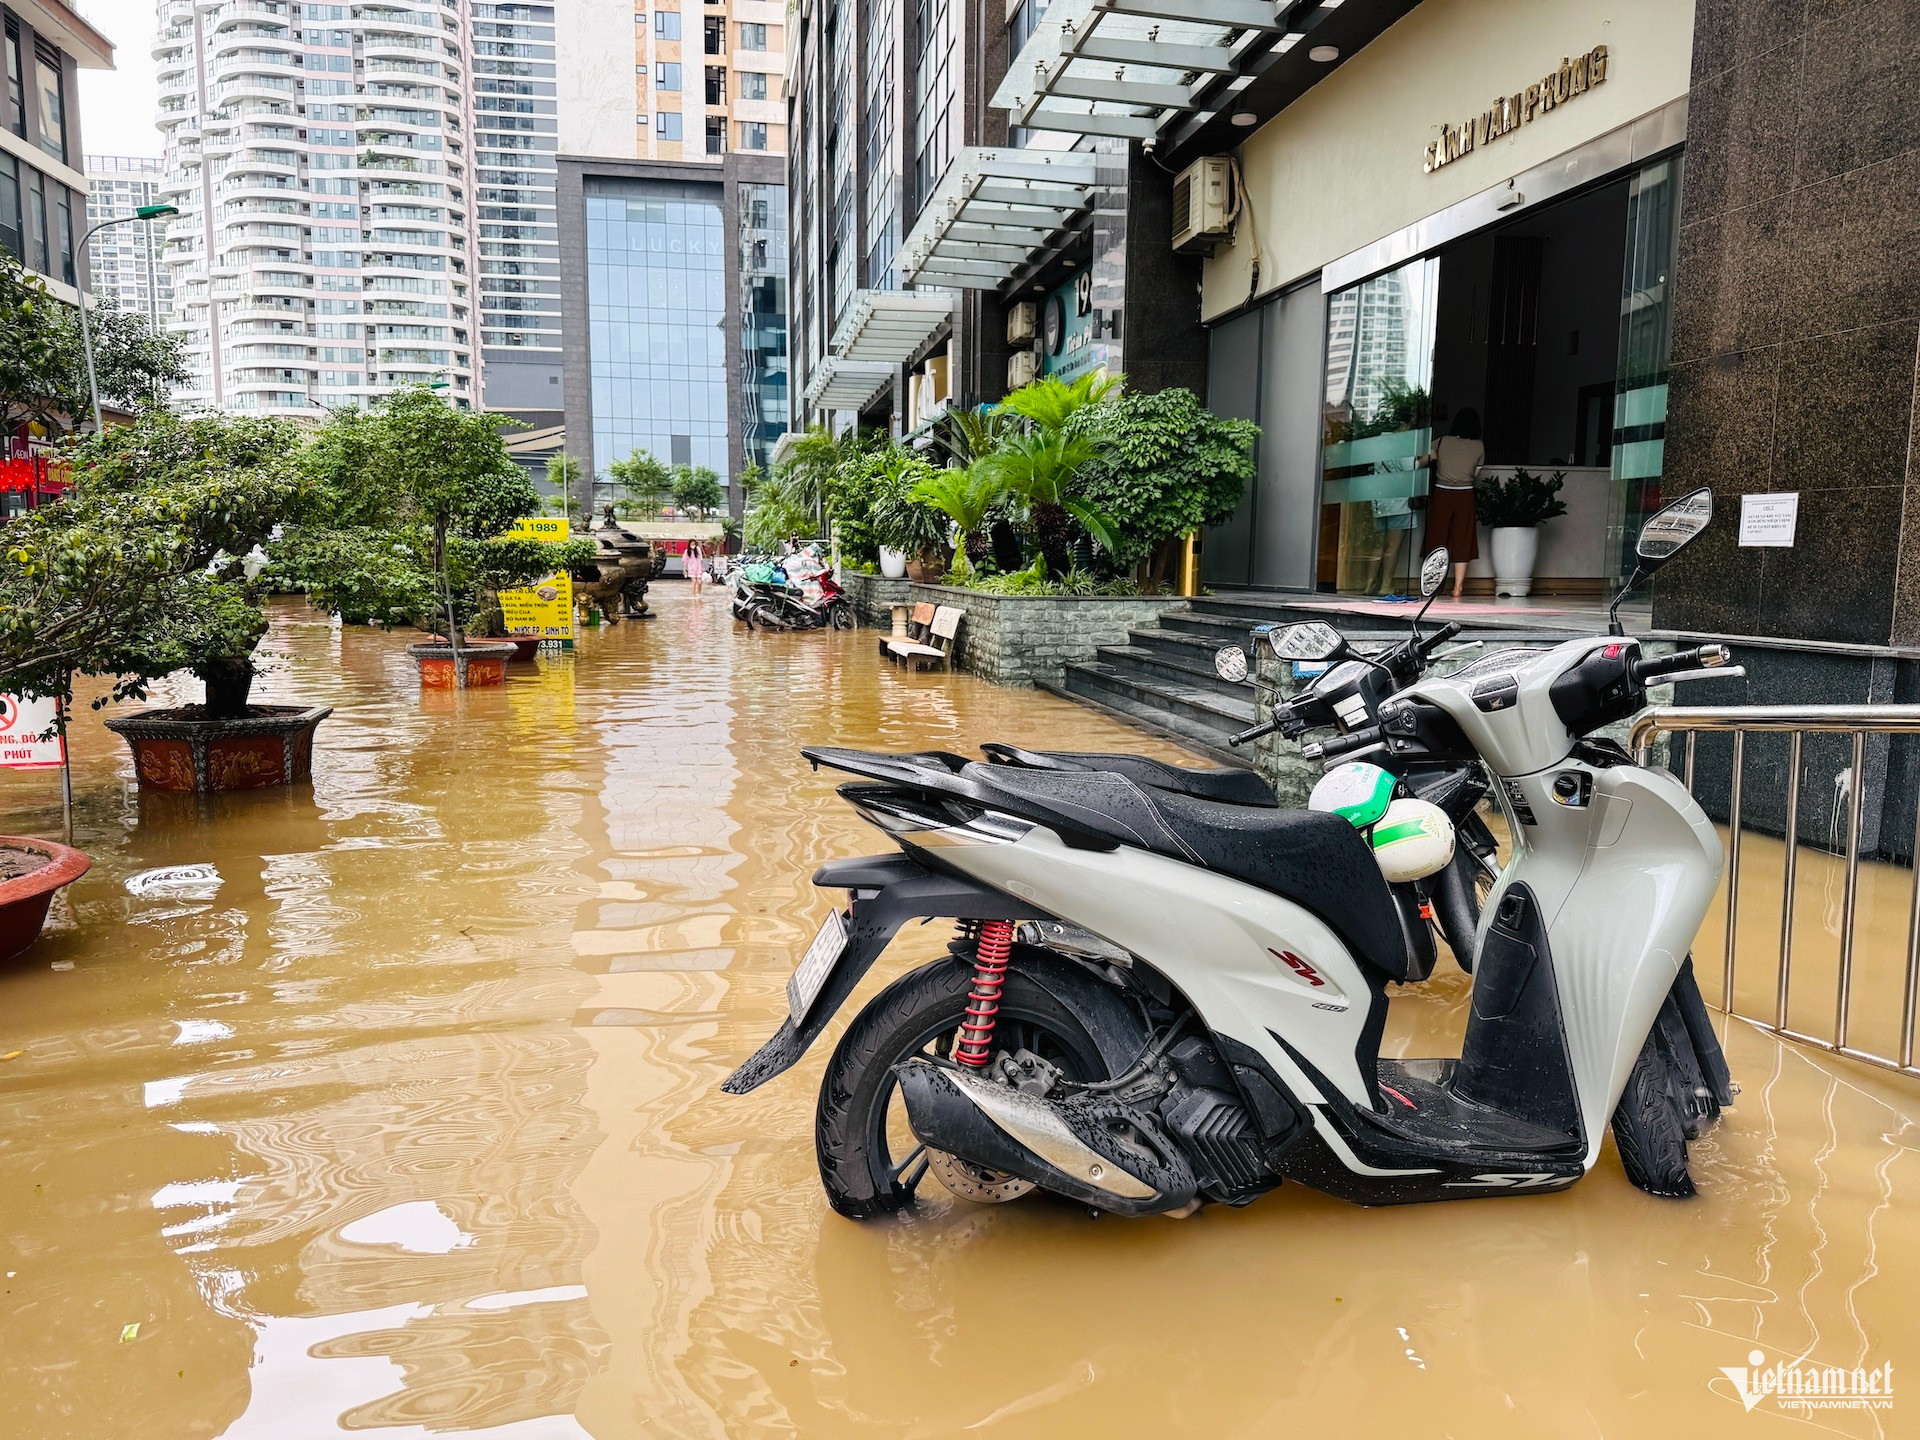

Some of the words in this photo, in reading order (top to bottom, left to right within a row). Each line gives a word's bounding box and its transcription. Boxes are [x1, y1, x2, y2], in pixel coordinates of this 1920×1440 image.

[1479, 92, 1523, 146] VĂN
[1524, 45, 1608, 122] PHÒNG
[631, 237, 721, 255] LUCKY
[529, 523, 558, 532] 1989
[545, 626, 559, 635] SINH
[4, 747, 32, 759] PHÚT
